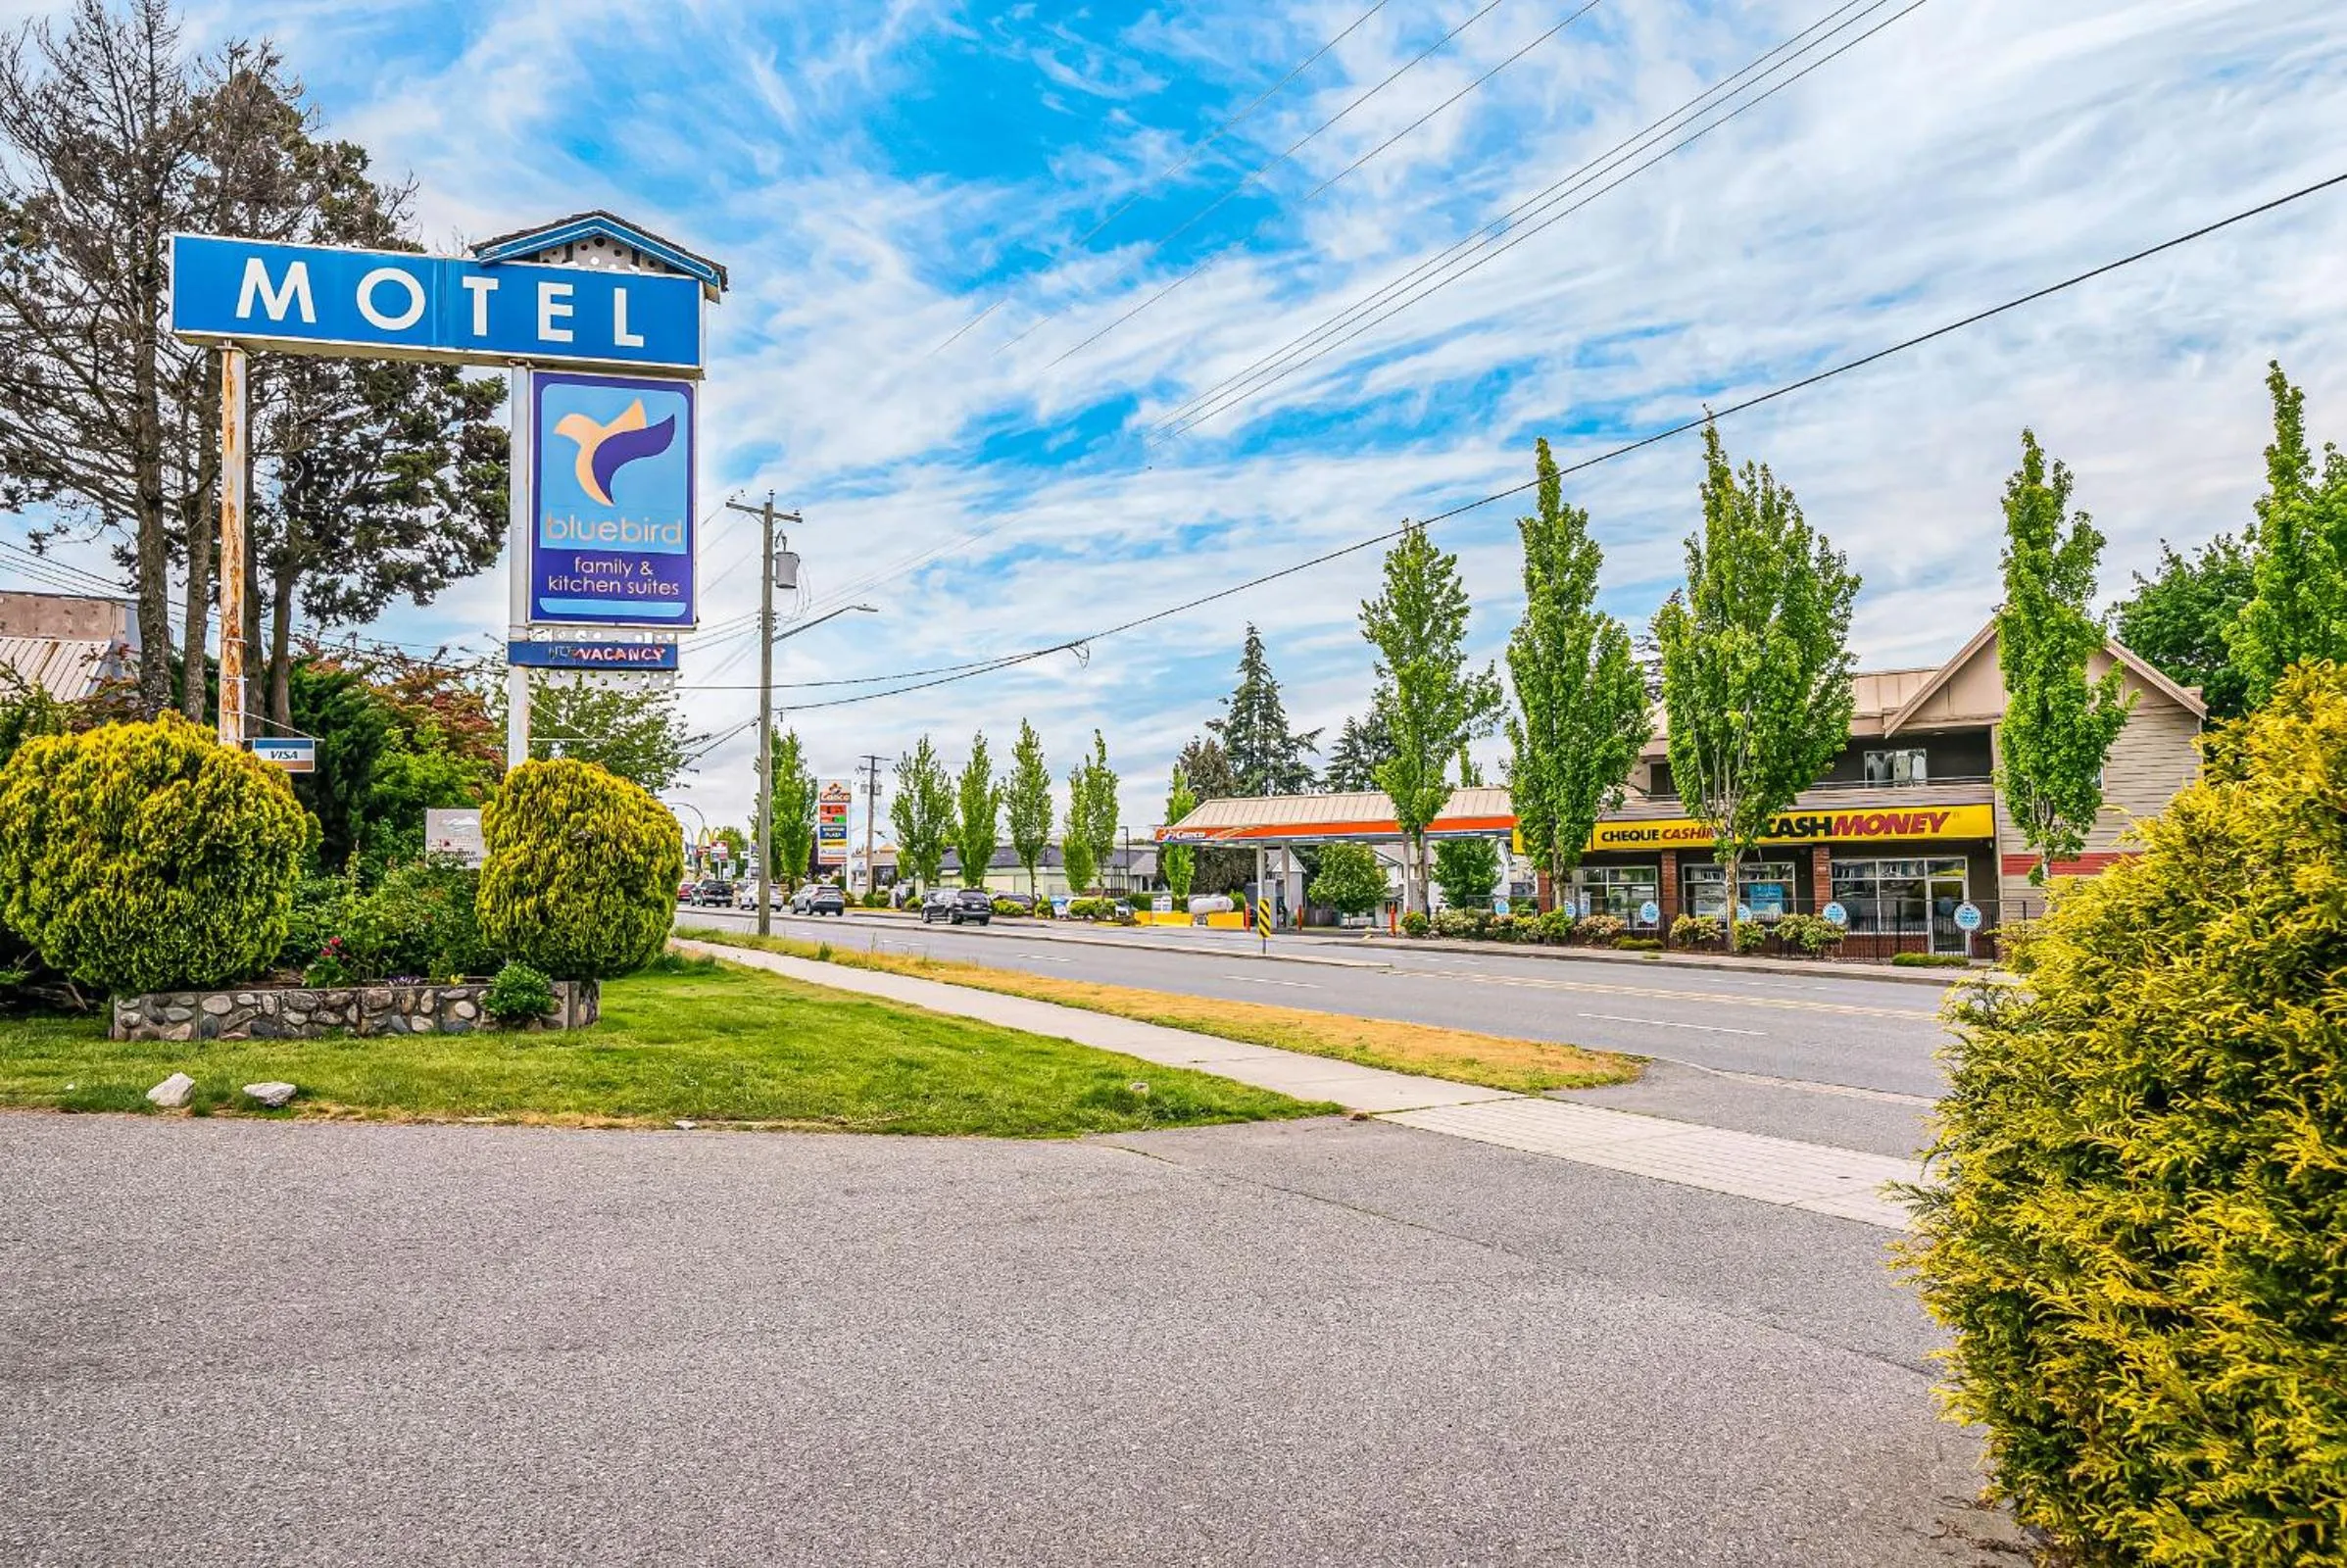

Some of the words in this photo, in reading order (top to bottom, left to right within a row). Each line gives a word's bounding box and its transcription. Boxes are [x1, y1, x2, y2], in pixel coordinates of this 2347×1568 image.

[235, 257, 644, 348] MOTEL
[545, 512, 683, 546] bluebird
[574, 556, 633, 577] family
[639, 561, 654, 576] &
[548, 575, 621, 594] kitchen
[626, 578, 680, 597] suites
[574, 647, 666, 662] VACANCY
[270, 751, 299, 760] VISA
[1601, 828, 1660, 843] CHEQUE
